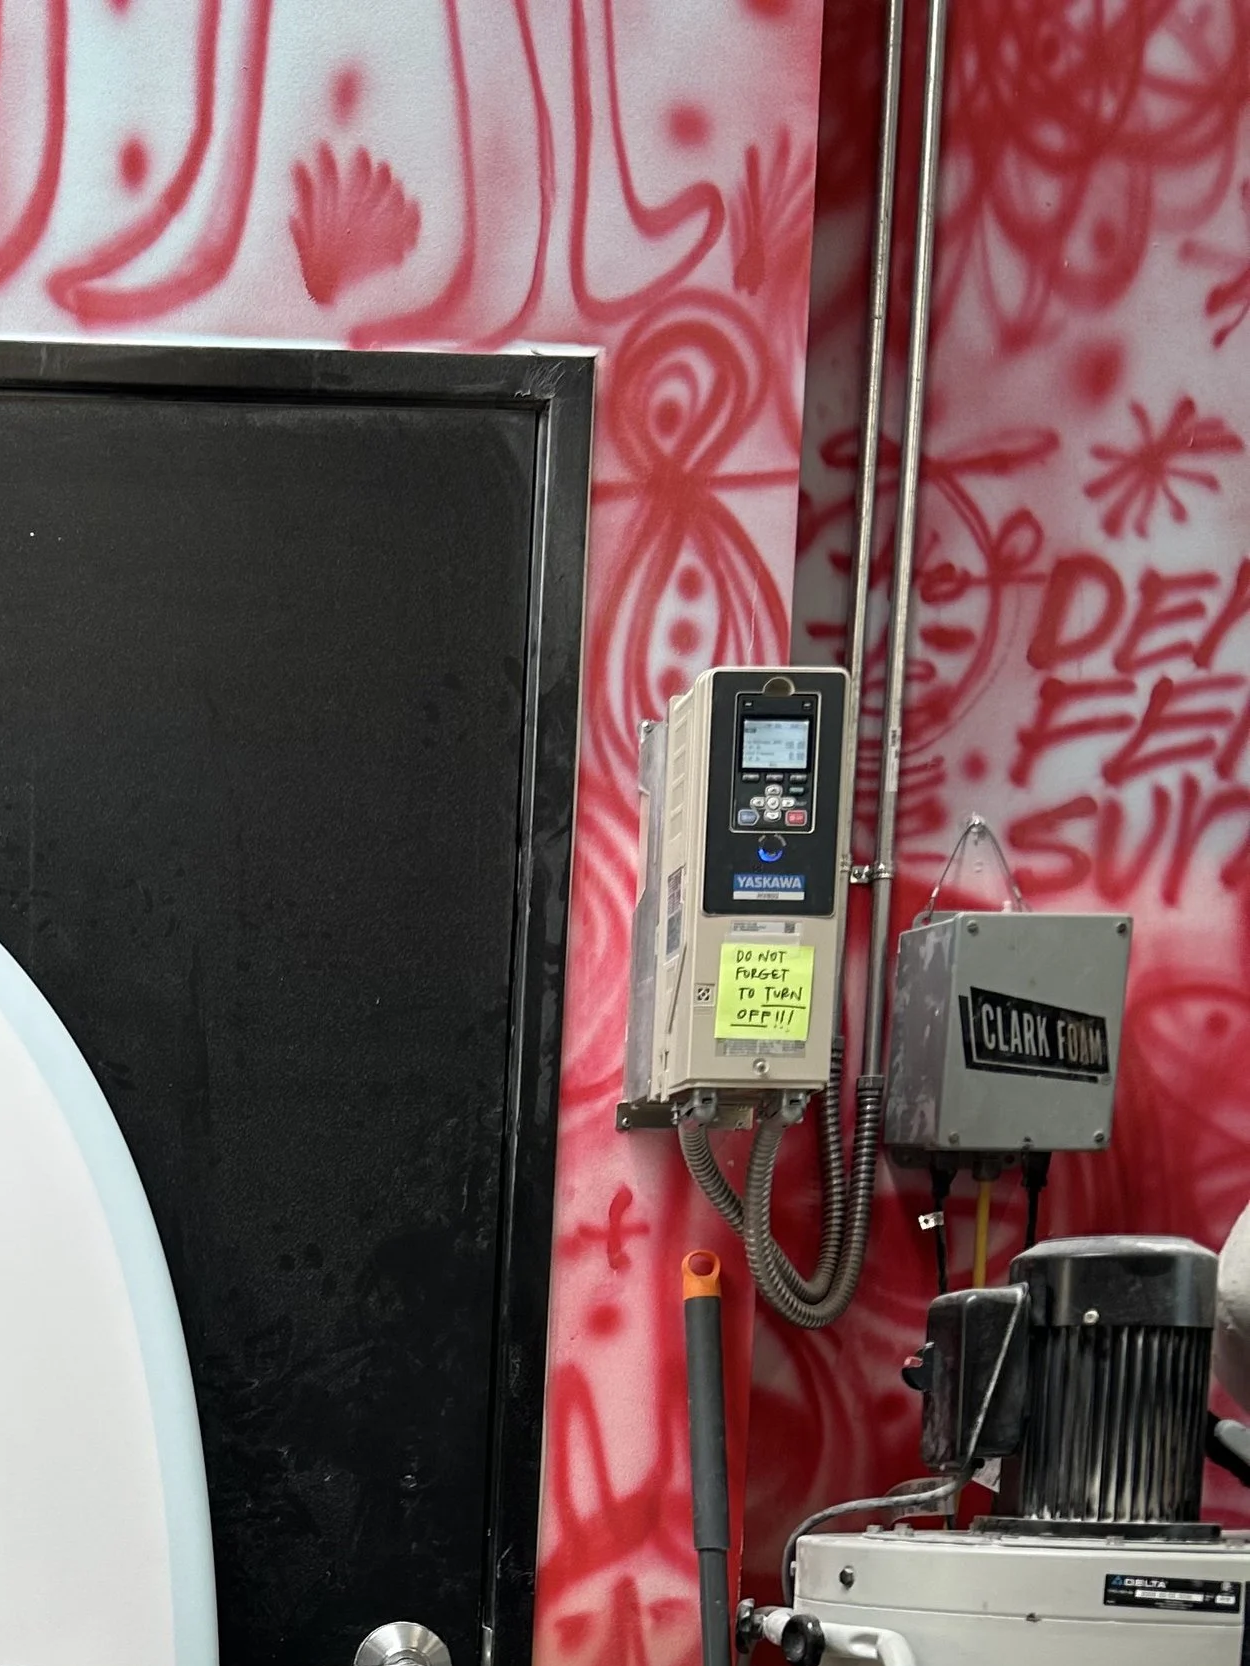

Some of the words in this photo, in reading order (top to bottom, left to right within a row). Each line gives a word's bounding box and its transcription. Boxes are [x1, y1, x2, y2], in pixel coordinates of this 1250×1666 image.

[737, 876, 802, 889] YASKAWA
[736, 950, 752, 963] DO
[758, 950, 787, 963] NOT
[735, 967, 790, 981] FORGET
[739, 987, 755, 1000] TO
[765, 986, 803, 1001] TURN
[737, 1009, 794, 1033] OFF!!!
[981, 1002, 1050, 1058] CLARK
[1057, 1019, 1103, 1066] FOAM
[1124, 1578, 1166, 1589] DELTA
